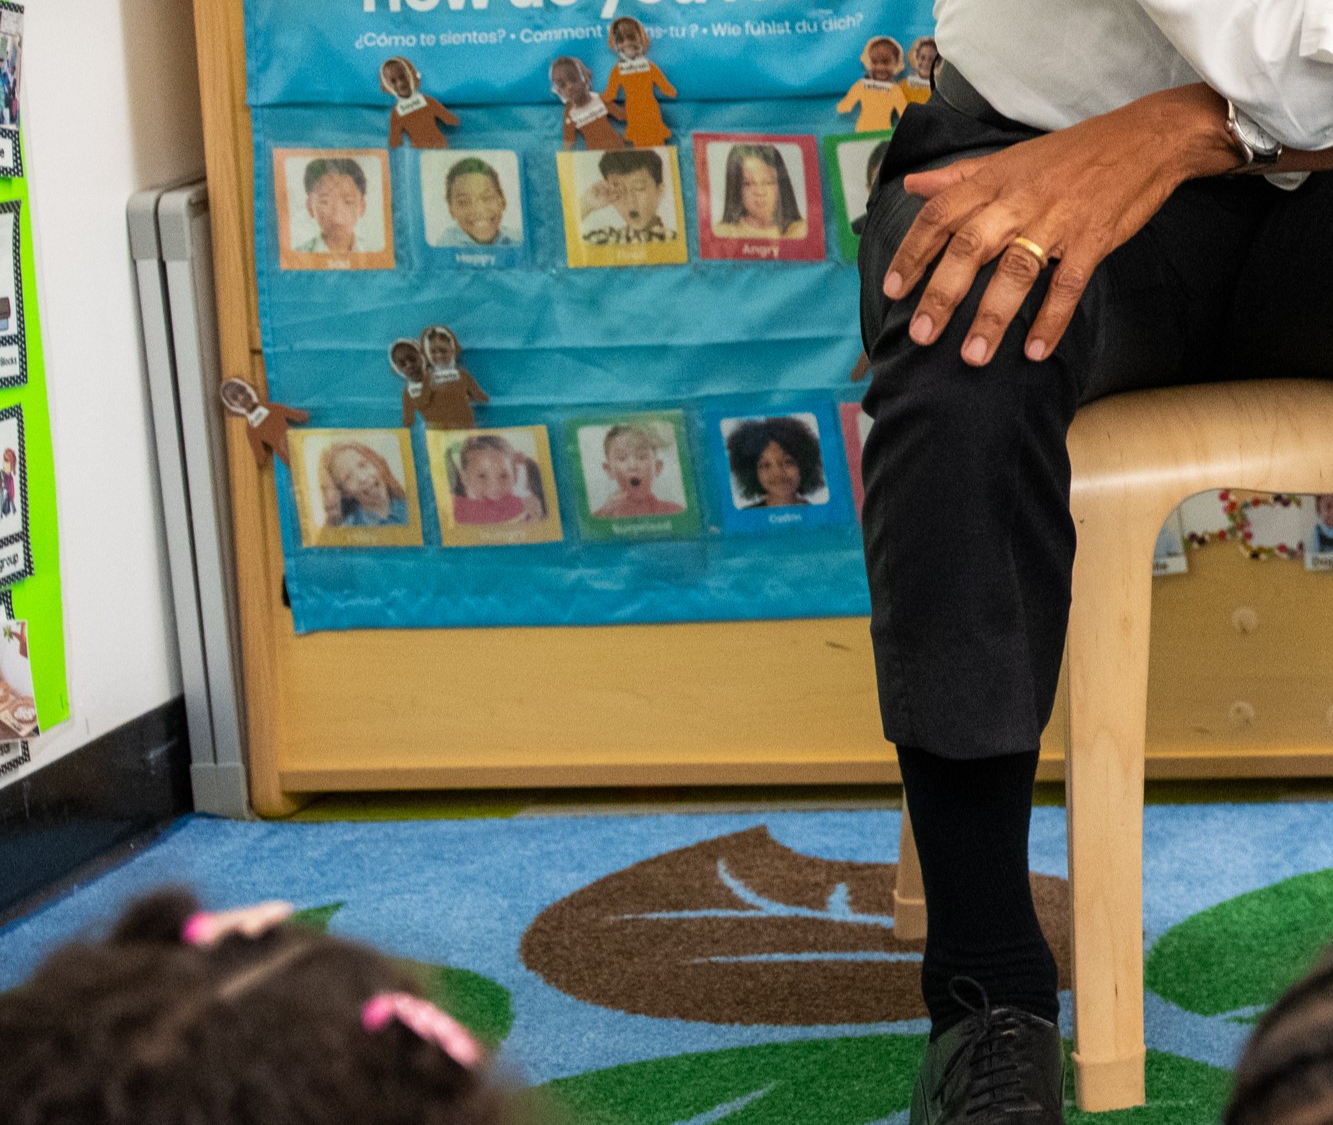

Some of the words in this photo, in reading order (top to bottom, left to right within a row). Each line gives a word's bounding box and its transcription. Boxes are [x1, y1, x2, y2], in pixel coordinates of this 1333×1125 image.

[355, 32, 416, 49] ¿Cómo
[420, 32, 436, 46] te
[441, 29, 505, 46] sientes?
[520, 25, 602, 43] Comment
[712, 22, 741, 36] Wie
[795, 19, 817, 33] du
[821, 13, 864, 32] dich?
[742, 244, 780, 259] Angry
